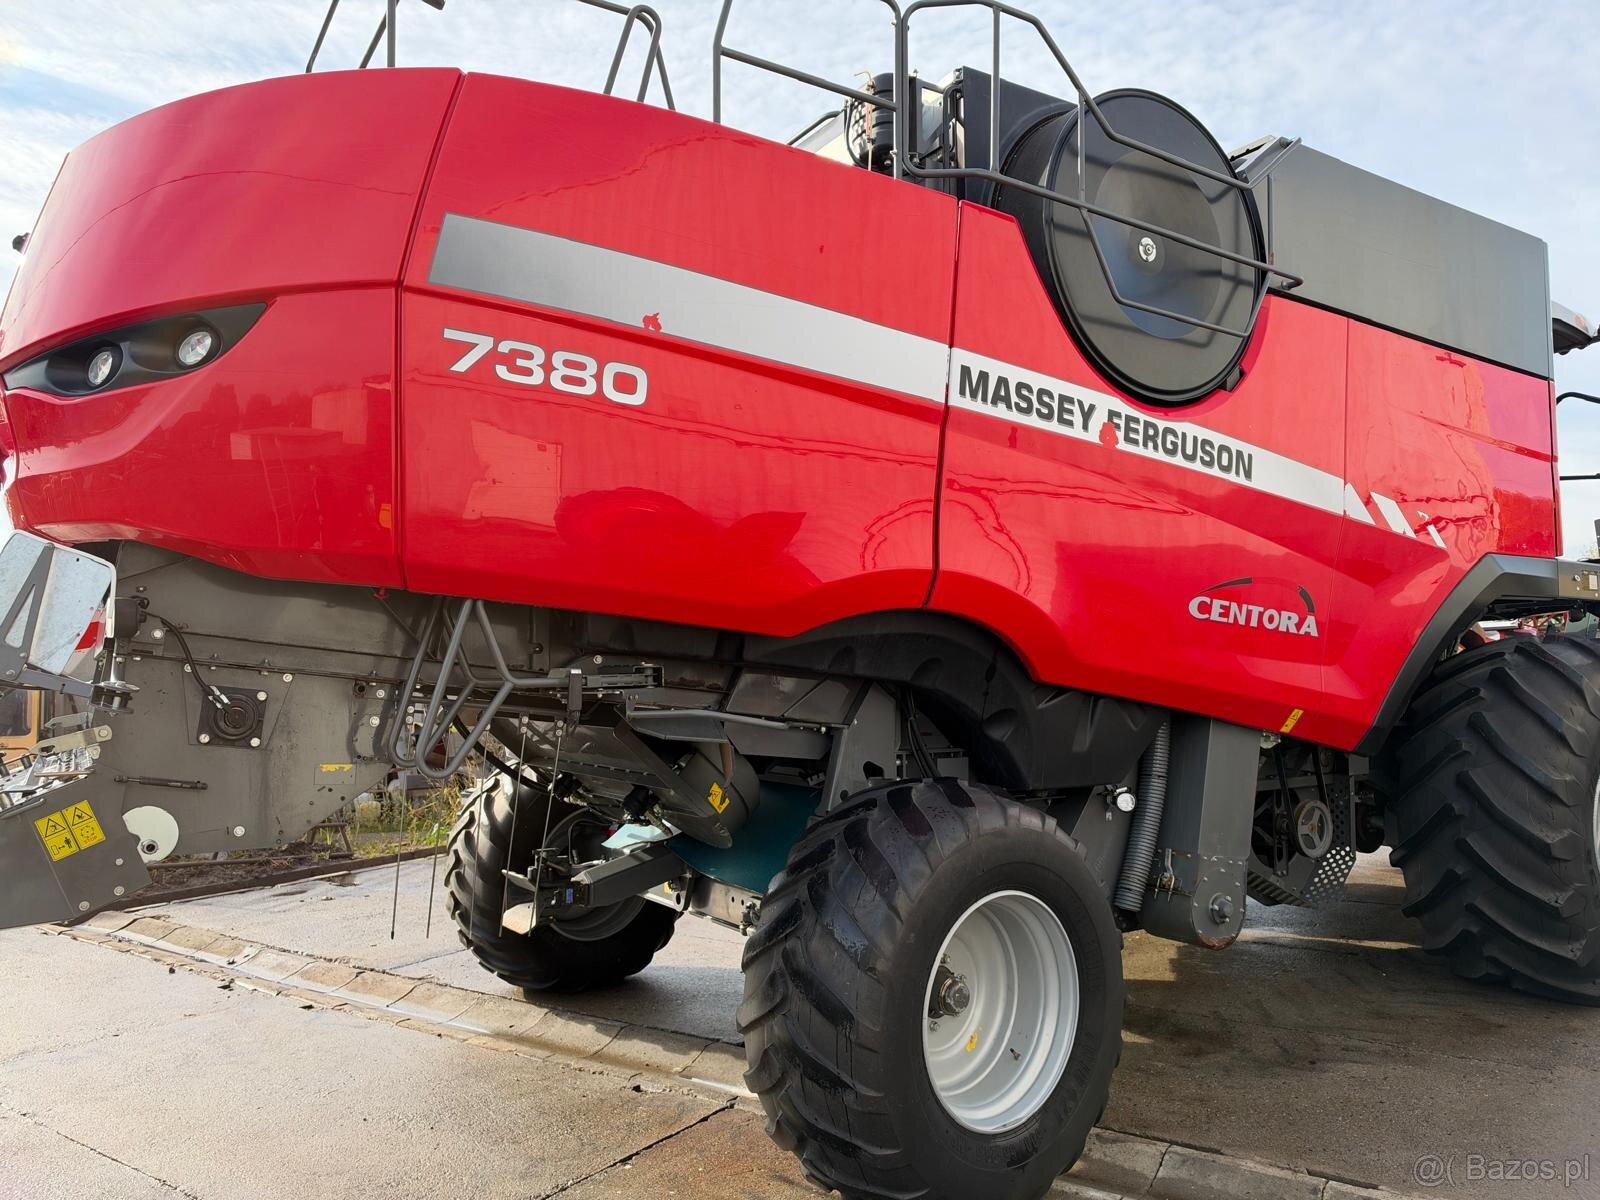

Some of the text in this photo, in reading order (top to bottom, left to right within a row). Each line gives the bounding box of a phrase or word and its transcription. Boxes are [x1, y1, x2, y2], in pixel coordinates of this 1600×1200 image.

[443, 327, 649, 407] 7380
[958, 363, 1253, 482] MASSEY FERGUSON
[1188, 596, 1319, 638] CENTORA
